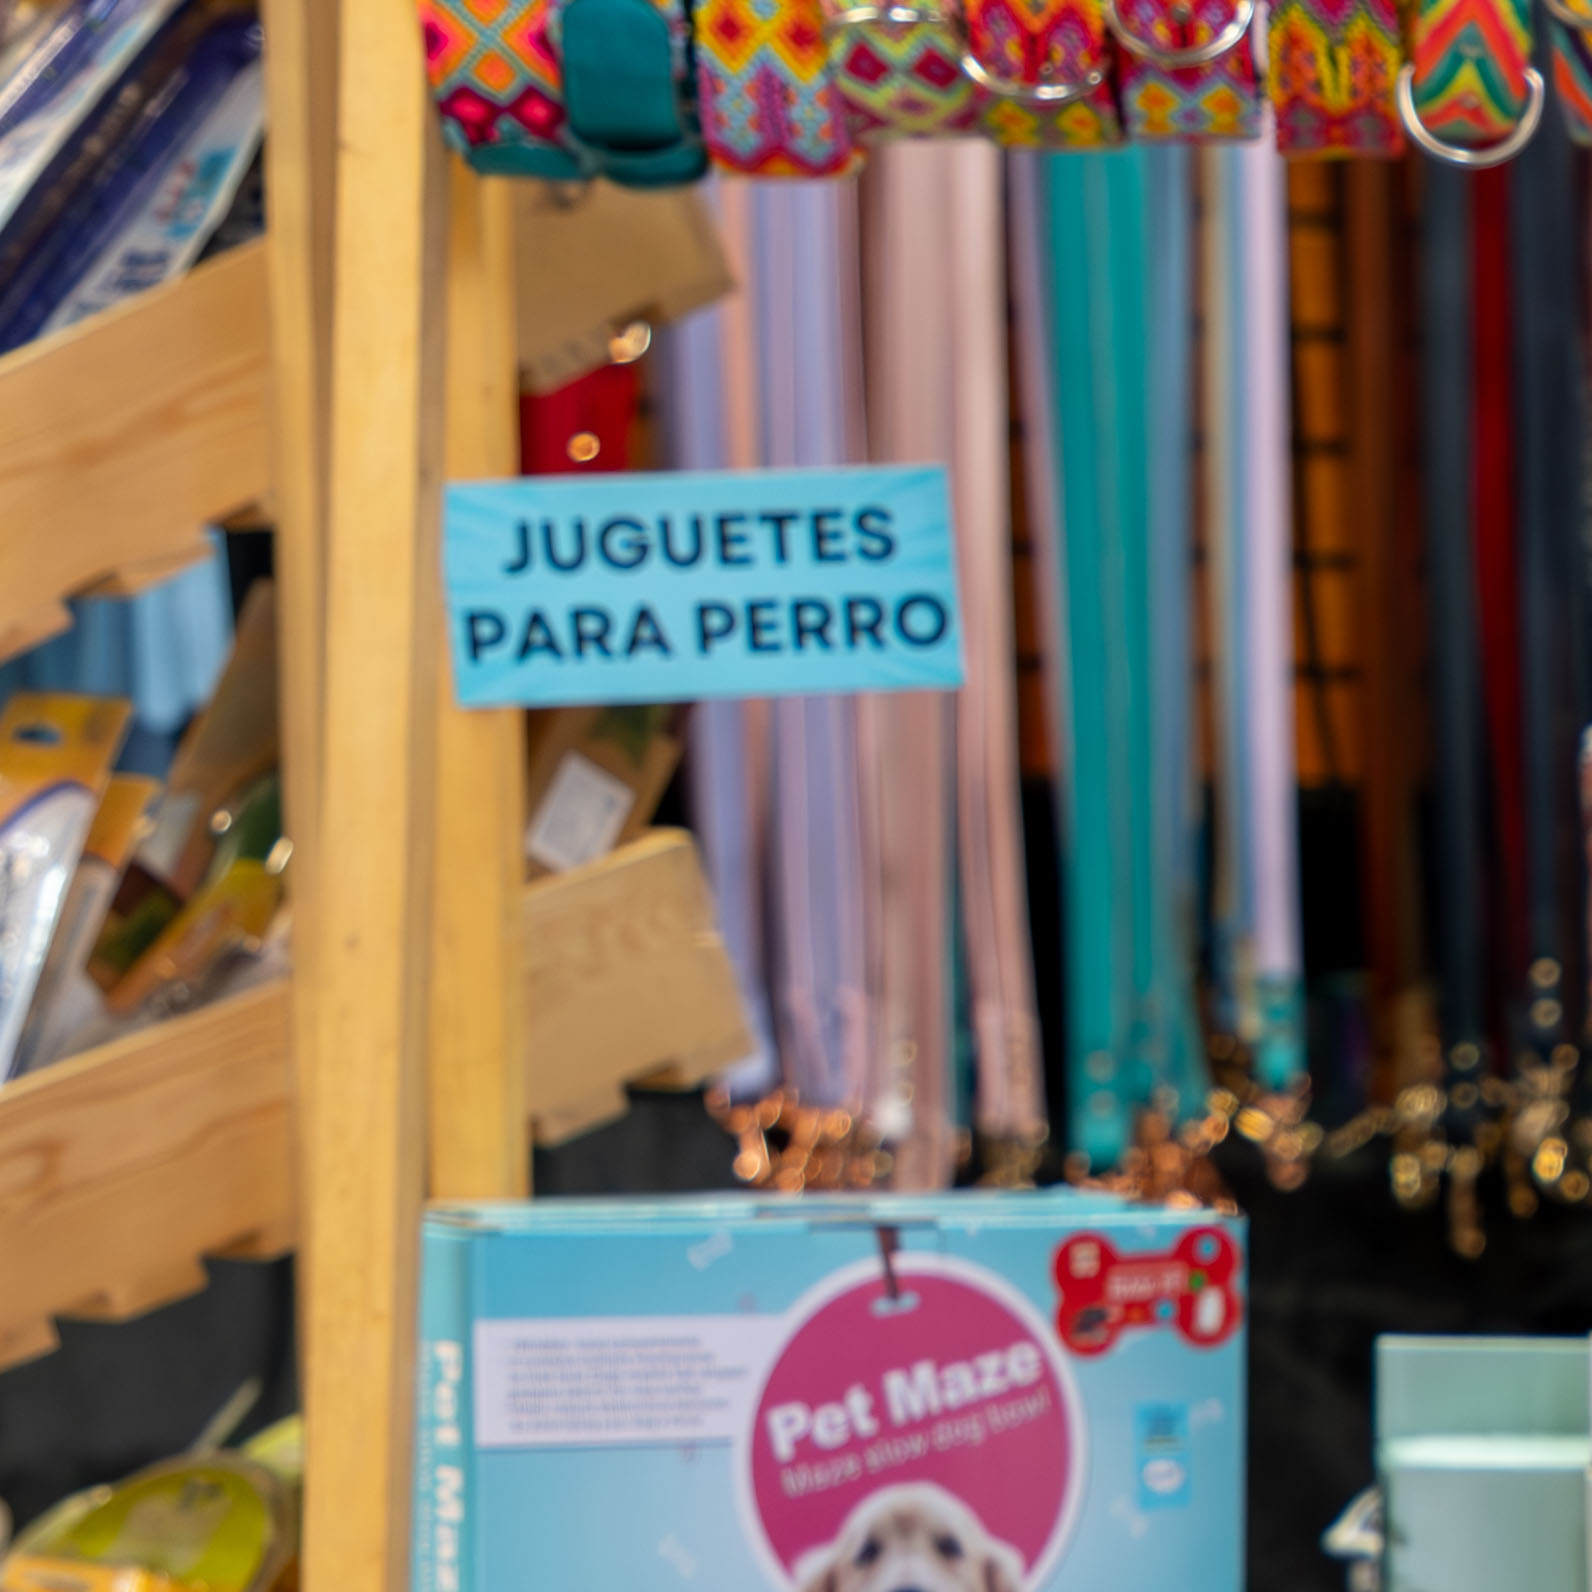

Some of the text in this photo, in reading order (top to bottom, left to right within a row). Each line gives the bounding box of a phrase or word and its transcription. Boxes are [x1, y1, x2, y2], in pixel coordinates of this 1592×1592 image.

[505, 505, 897, 575] JUGUETES
[465, 592, 951, 664] PARA PERRO
[434, 1339, 463, 1448] Pet
[766, 1382, 880, 1463] Pet
[882, 1340, 1043, 1428] Maze
[781, 1450, 863, 1499] Maze
[864, 1432, 930, 1475] slow
[931, 1411, 986, 1449] dog
